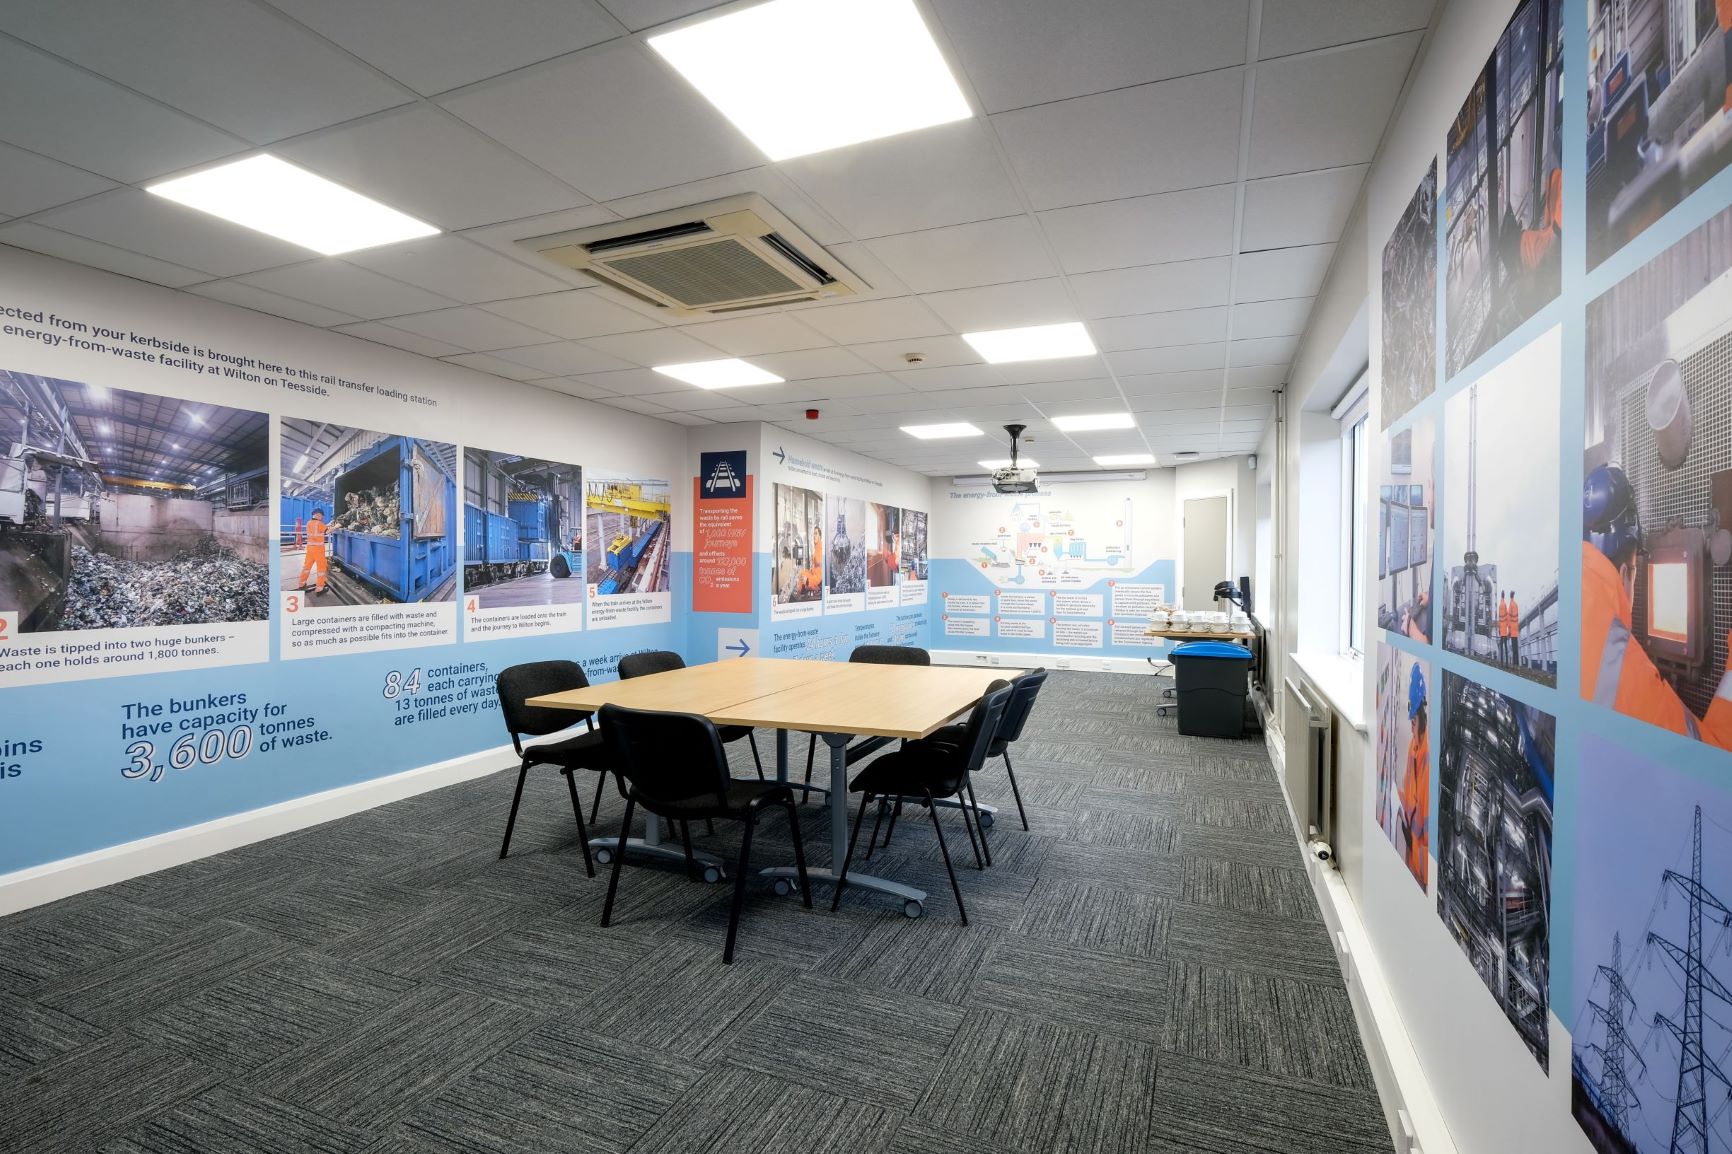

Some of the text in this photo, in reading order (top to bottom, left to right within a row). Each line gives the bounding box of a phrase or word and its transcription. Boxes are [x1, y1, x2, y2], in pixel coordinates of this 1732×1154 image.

[3, 324, 330, 397] energy-from-waste facility at Wilton on Teesside.
[48, 314, 87, 333] from
[92, 326, 126, 341] your
[130, 331, 189, 354] kerbside
[193, 346, 205, 358] is
[208, 349, 255, 368] brought
[258, 360, 283, 374] here
[286, 366, 296, 377] to
[299, 369, 318, 381] this
[320, 375, 336, 385] rail
[338, 378, 375, 393] transfer
[376, 386, 408, 402] loading
[409, 393, 437, 407] station
[589, 587, 595, 598] 5
[286, 596, 299, 613] 3
[467, 599, 476, 613] 4
[0, 618, 8, 640] 2
[291, 626, 341, 637] compressed
[342, 625, 358, 633] with
[365, 622, 406, 632] compacting
[406, 620, 436, 628] machine,
[292, 618, 315, 626] Large
[316, 616, 357, 625] containers
[371, 613, 388, 621] filled
[389, 612, 404, 620] with
[0, 647, 41, 658] Waste
[45, 645, 57, 654] is
[60, 641, 101, 655] tipped
[104, 641, 127, 650] into
[130, 639, 152, 648] two
[155, 637, 182, 647] huge
[184, 634, 226, 645] bunkers
[315, 637, 337, 645] much
[349, 633, 380, 644] possible
[0, 647, 219, 672] each one holds around 1,800 tonnes.
[427, 662, 488, 678] containers,
[588, 655, 608, 665] week
[383, 667, 421, 699] 84
[427, 678, 455, 692] each
[121, 693, 247, 720] The bunkers
[395, 698, 410, 711] 13
[414, 693, 453, 708] tonnes
[456, 688, 468, 701] of
[122, 702, 287, 739] have capacity for
[394, 698, 501, 726] are filled every day.
[259, 716, 315, 736] tonnes
[0, 740, 42, 757] ins
[259, 728, 333, 752] of waste.
[120, 724, 254, 783] 3,600
